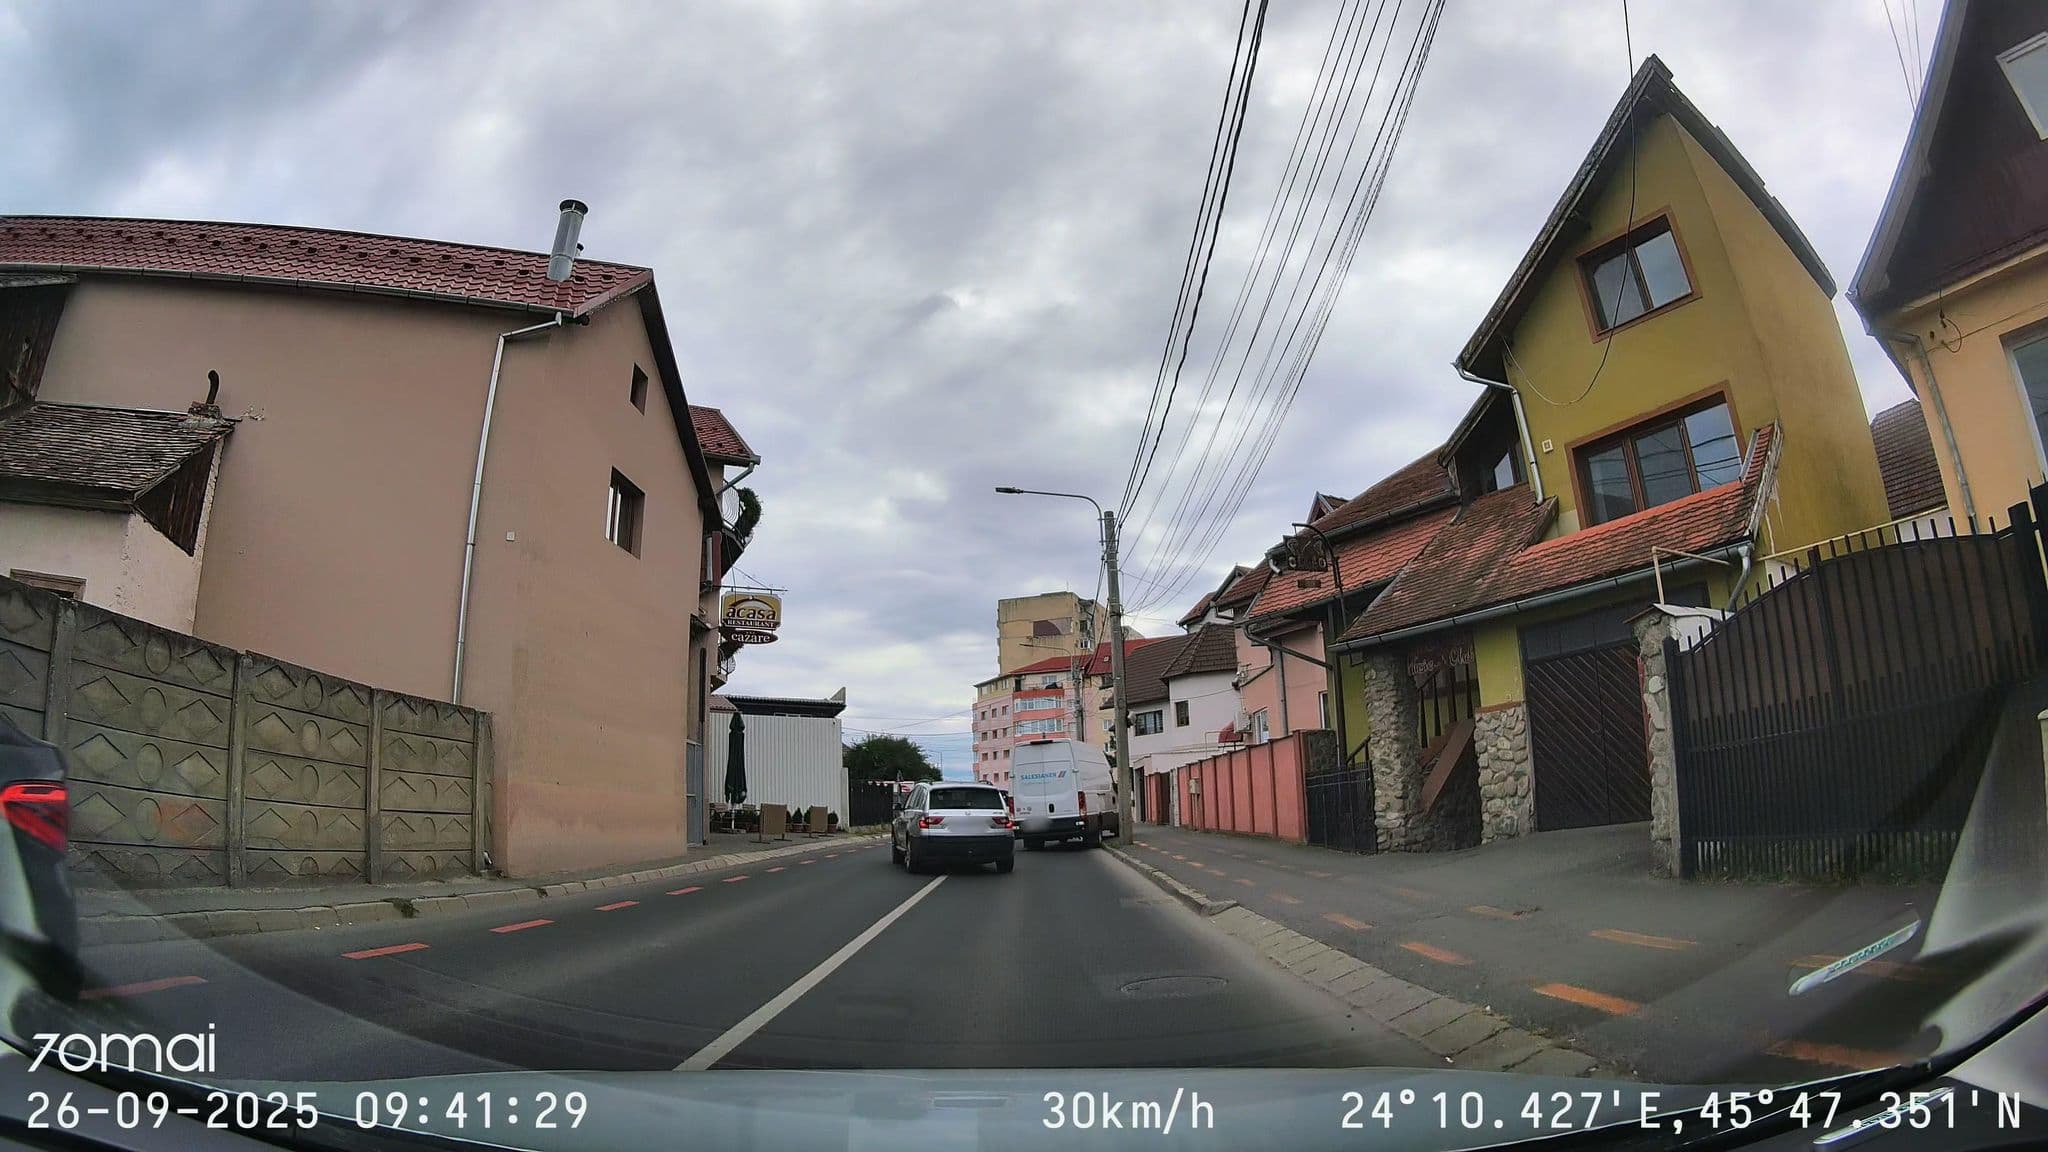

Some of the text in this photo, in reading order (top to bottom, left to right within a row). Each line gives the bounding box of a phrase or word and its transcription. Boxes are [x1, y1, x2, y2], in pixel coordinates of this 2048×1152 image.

[726, 606, 776, 620] acasa
[727, 619, 775, 628] RESTAURANT
[731, 633, 770, 643] cazare
